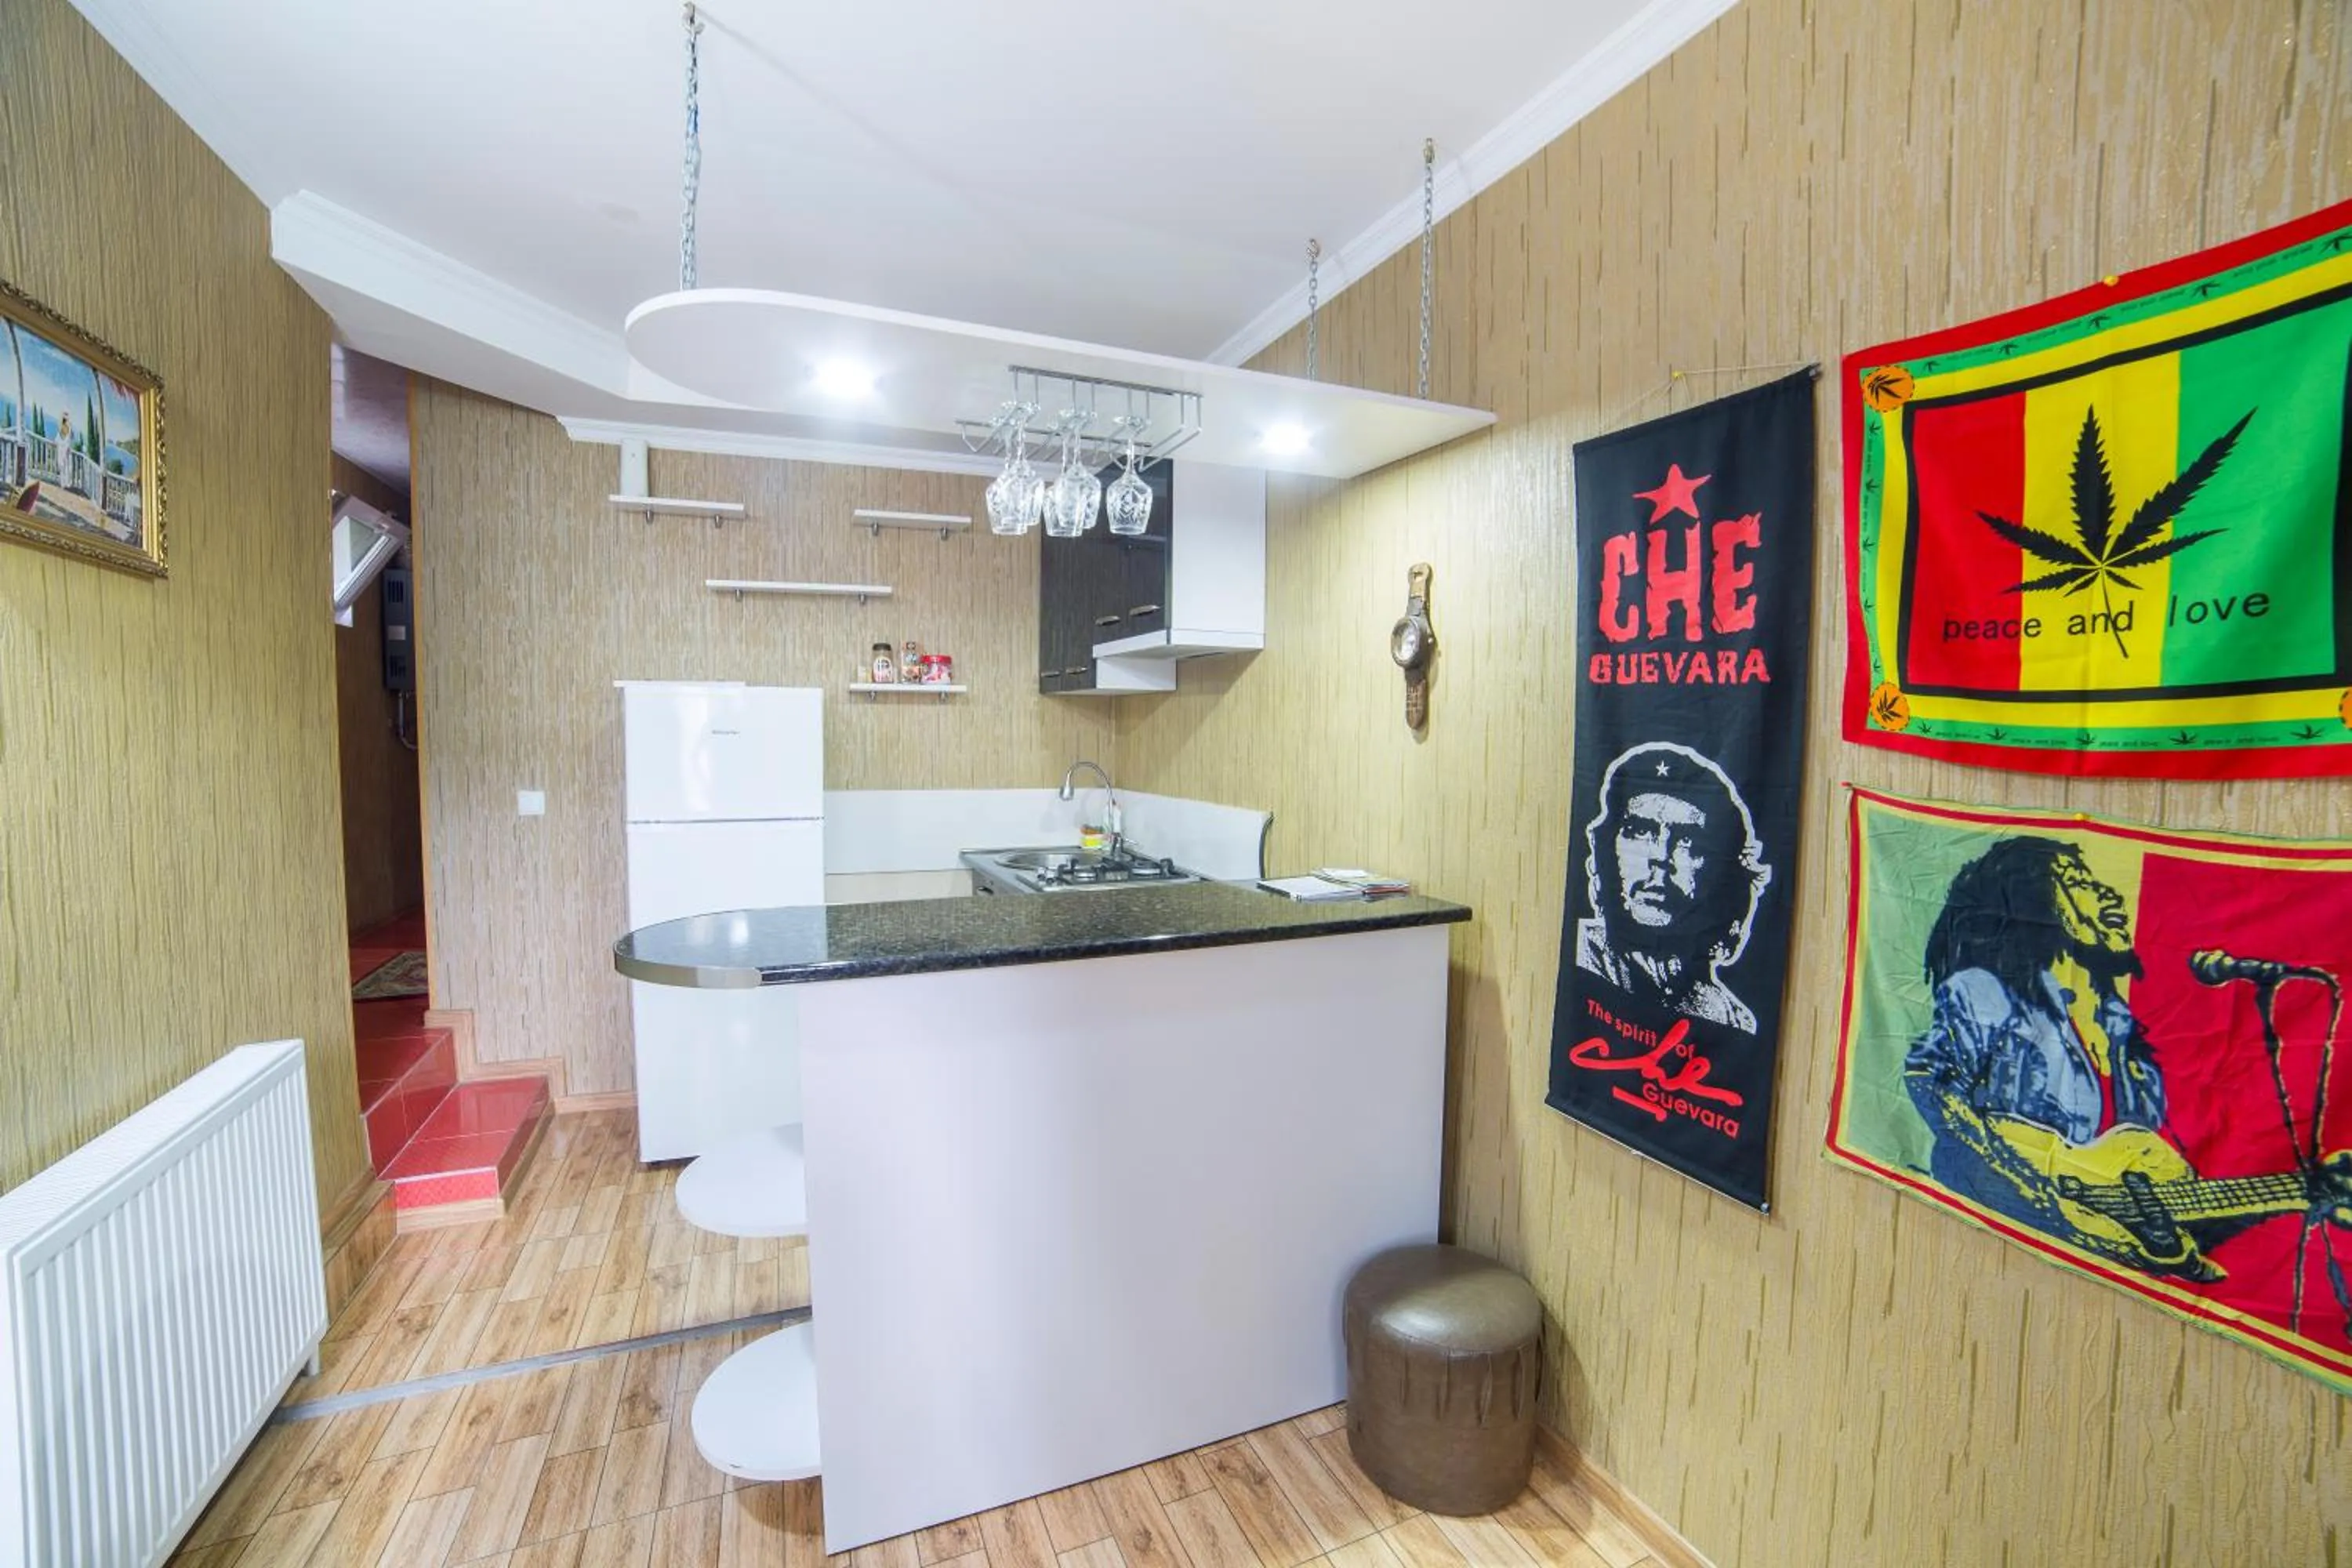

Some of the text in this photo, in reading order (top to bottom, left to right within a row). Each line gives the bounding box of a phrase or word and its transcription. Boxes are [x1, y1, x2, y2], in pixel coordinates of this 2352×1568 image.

[1599, 512, 1762, 642] CHE
[1942, 590, 2270, 642] peace and love
[1588, 648, 1771, 684] GUEVARA
[1586, 998, 1696, 1059] The spirit of
[1642, 1083, 1740, 1139] Guevara
